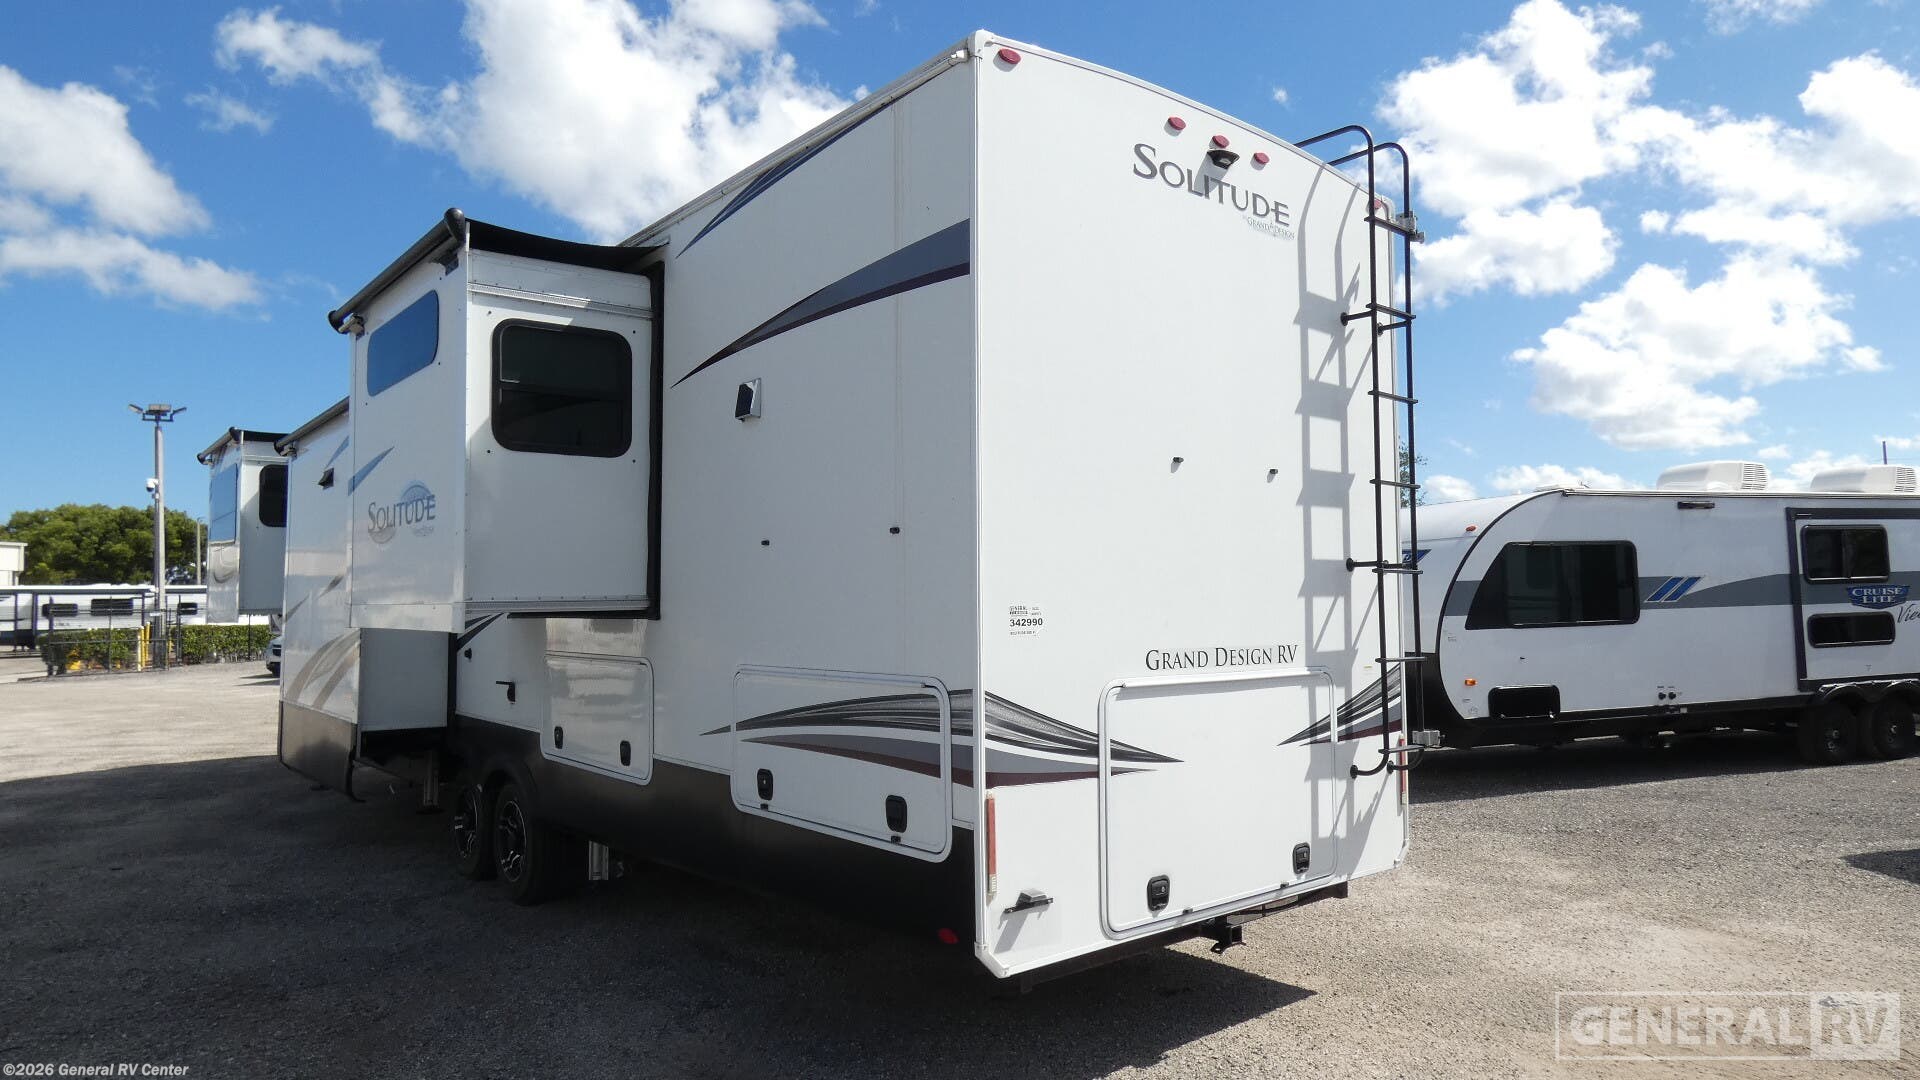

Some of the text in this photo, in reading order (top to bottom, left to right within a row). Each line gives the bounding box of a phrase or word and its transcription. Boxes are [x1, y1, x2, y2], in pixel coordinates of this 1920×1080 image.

[1852, 587, 1903, 597] CRUISE
[1862, 595, 1896, 604] LITE
[1009, 617, 1043, 627] 342990
[1277, 644, 1298, 664] RV
